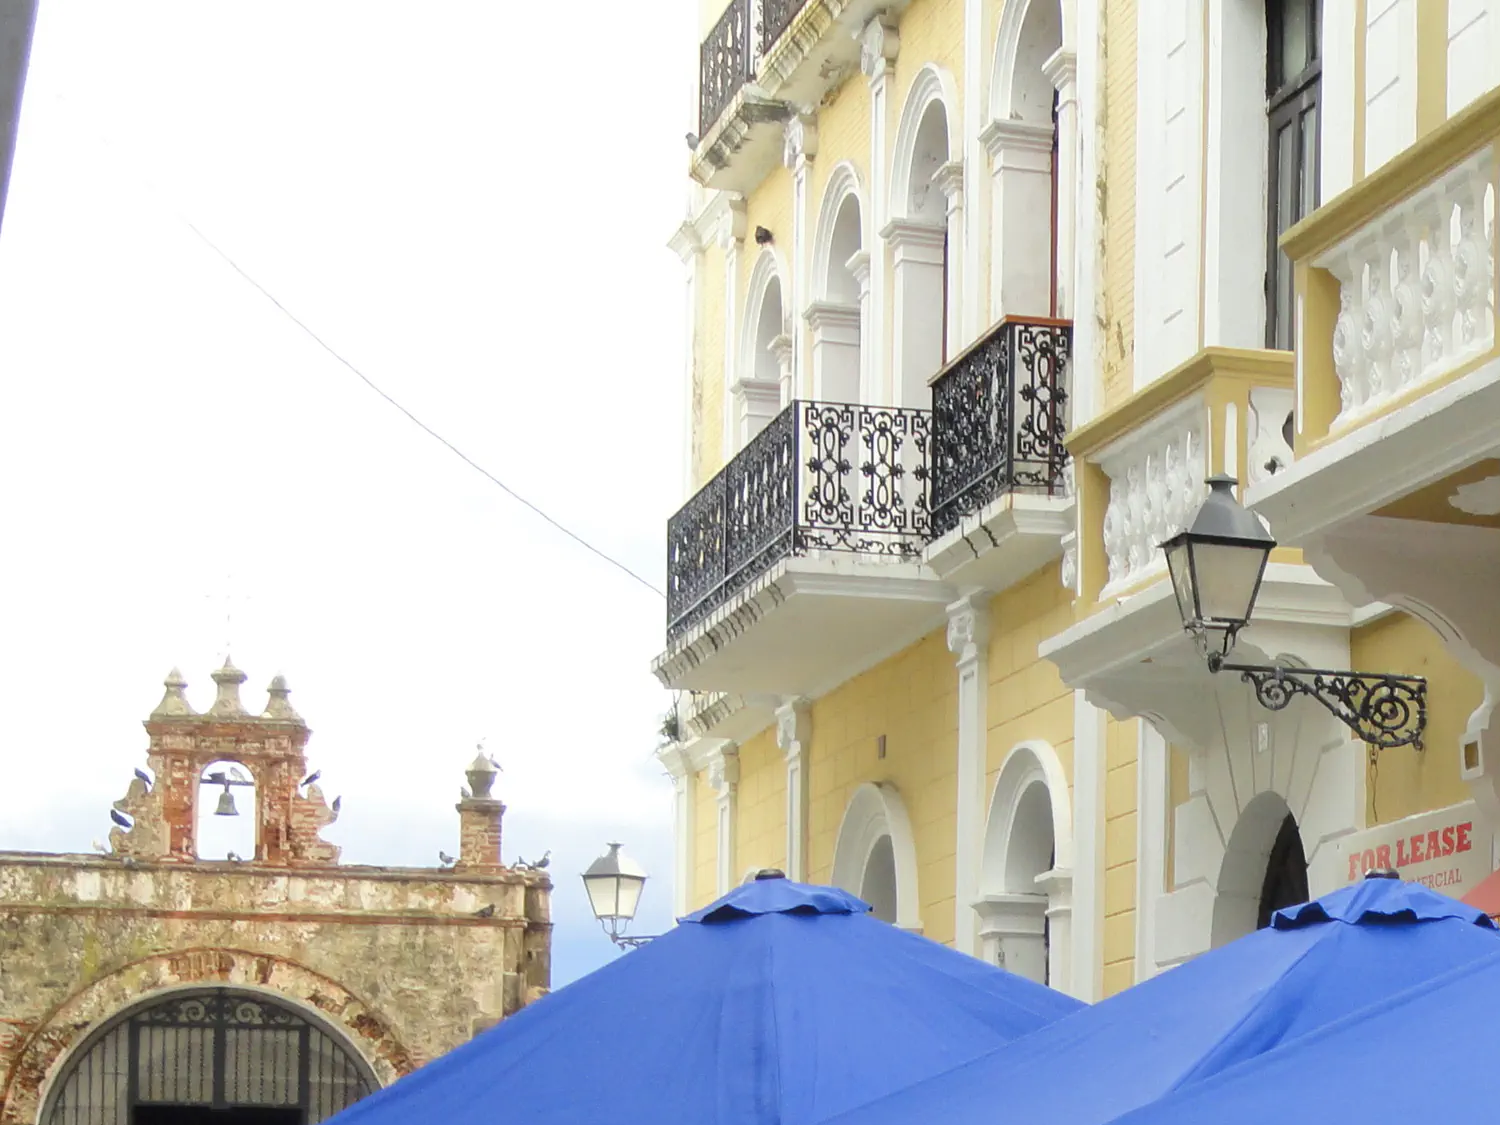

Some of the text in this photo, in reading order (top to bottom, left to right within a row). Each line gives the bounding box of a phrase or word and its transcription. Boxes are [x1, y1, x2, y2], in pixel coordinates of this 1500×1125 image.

[1348, 822, 1473, 881] FOR LEASE
[1404, 868, 1463, 889] ERCIAL
